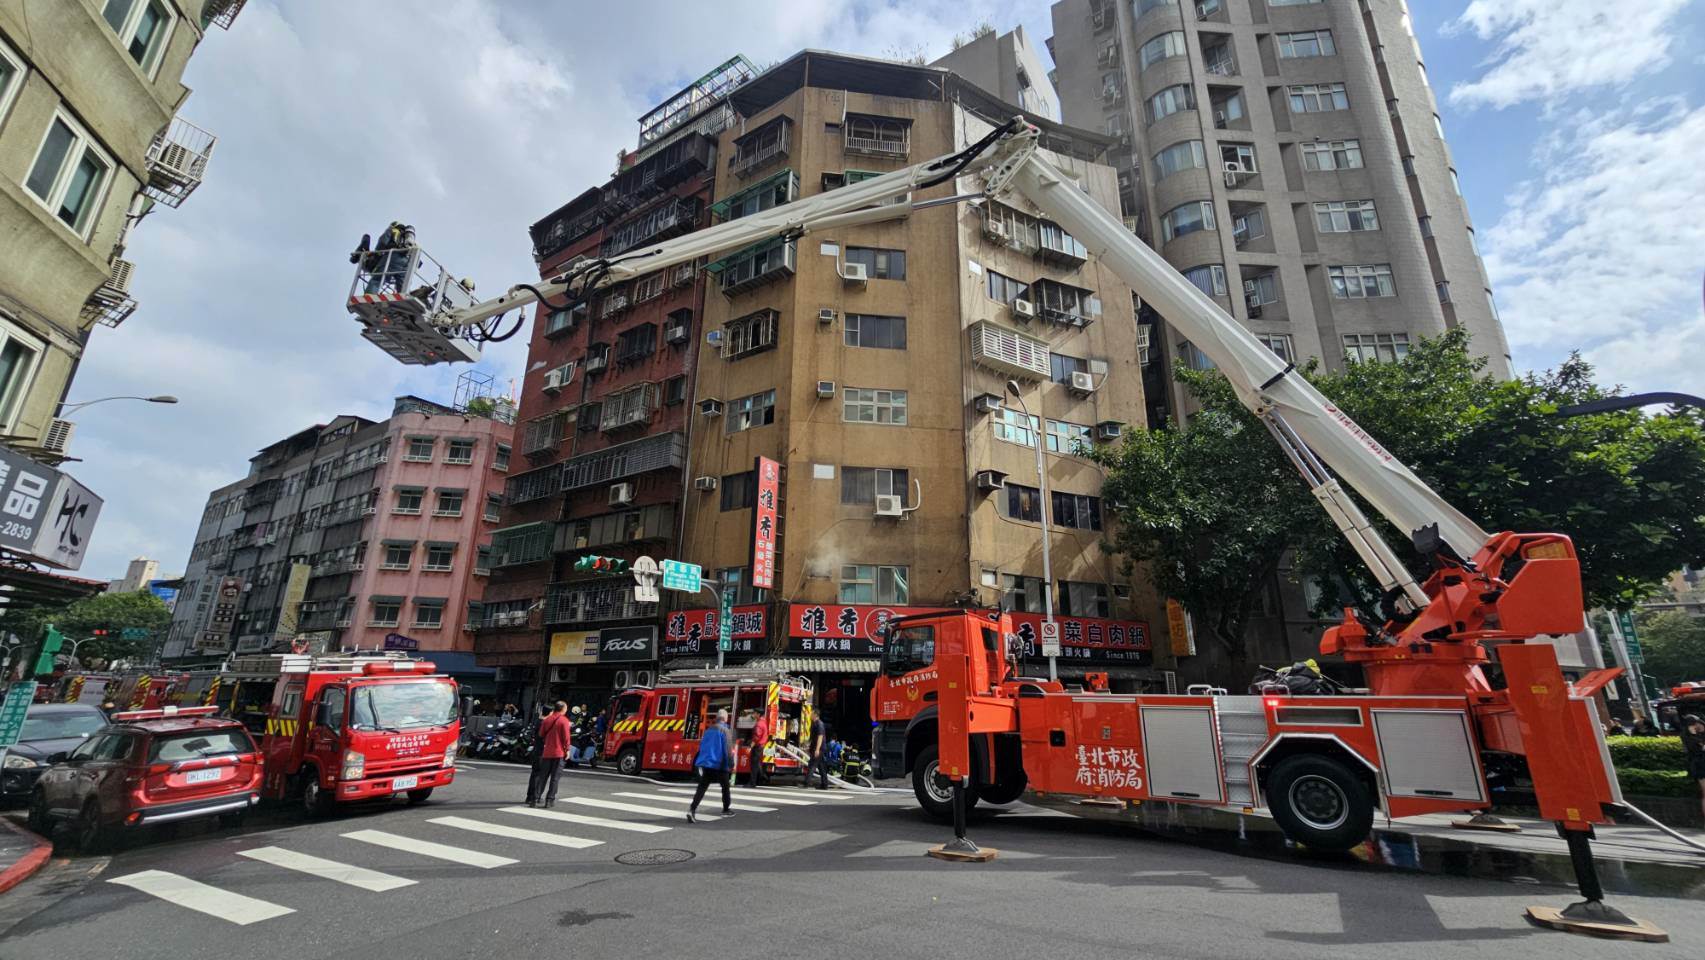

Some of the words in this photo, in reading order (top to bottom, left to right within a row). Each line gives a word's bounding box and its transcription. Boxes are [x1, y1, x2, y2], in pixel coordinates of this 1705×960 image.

[760, 488, 774, 539] 雅香
[669, 611, 702, 652] 雅香
[801, 605, 859, 637] 雅香
[603, 638, 649, 651] FOCUS
[802, 638, 851, 651] 石頭火鍋
[1063, 619, 1145, 648] 菜白肉鍋
[1061, 647, 1091, 658] 頭火鍋
[1106, 651, 1124, 659] Since
[1074, 744, 1142, 769] 臺北市政
[1074, 766, 1142, 790] 府消防局
